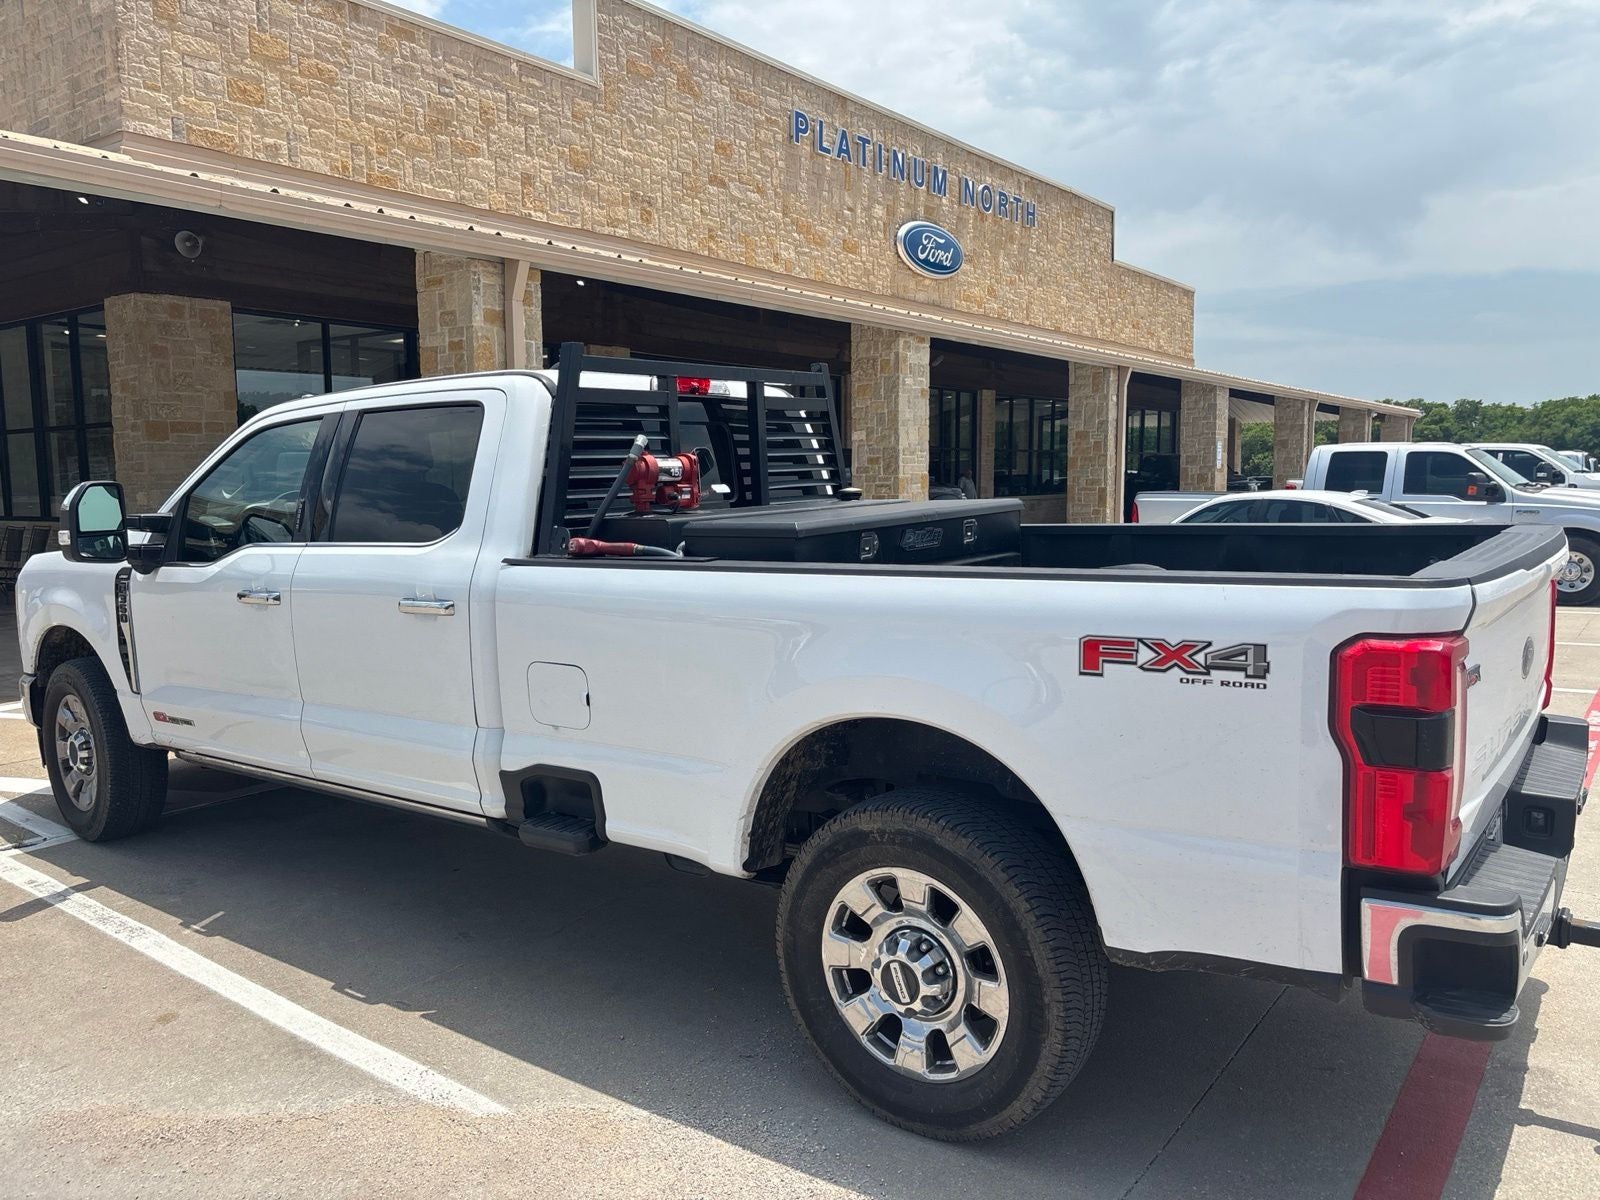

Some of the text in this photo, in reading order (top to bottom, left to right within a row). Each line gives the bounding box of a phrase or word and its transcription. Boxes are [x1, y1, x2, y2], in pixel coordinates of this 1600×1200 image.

[791, 109, 1038, 228] PLATINUM NORTH
[917, 232, 954, 267] Ford
[1079, 634, 1270, 679] FX4
[1179, 676, 1268, 690] OFF ROAD
